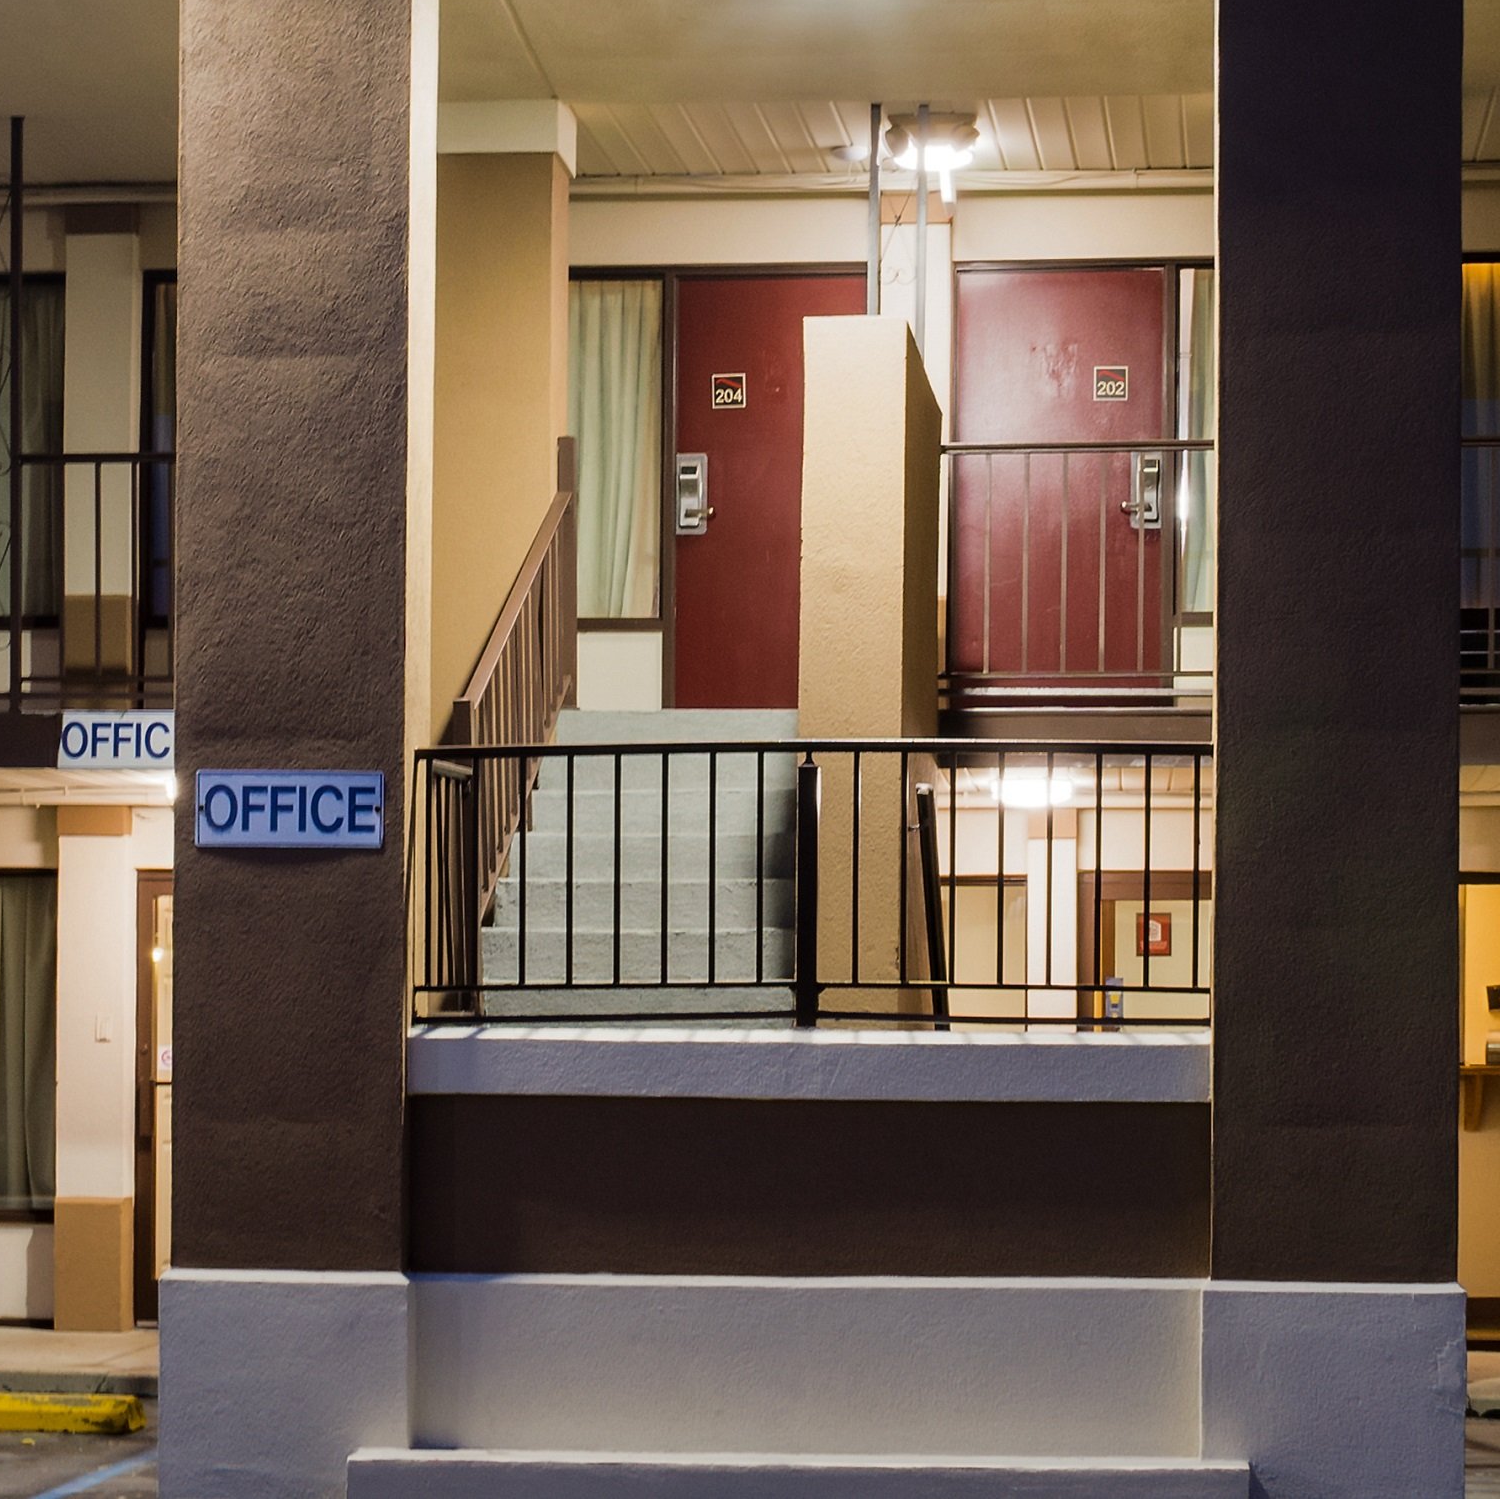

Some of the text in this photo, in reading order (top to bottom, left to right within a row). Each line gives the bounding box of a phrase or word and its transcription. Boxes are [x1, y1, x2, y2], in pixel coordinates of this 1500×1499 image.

[715, 388, 742, 404] 204
[1097, 381, 1125, 396] 202
[61, 721, 171, 759] OFFIC
[205, 784, 376, 832] OFFICE
